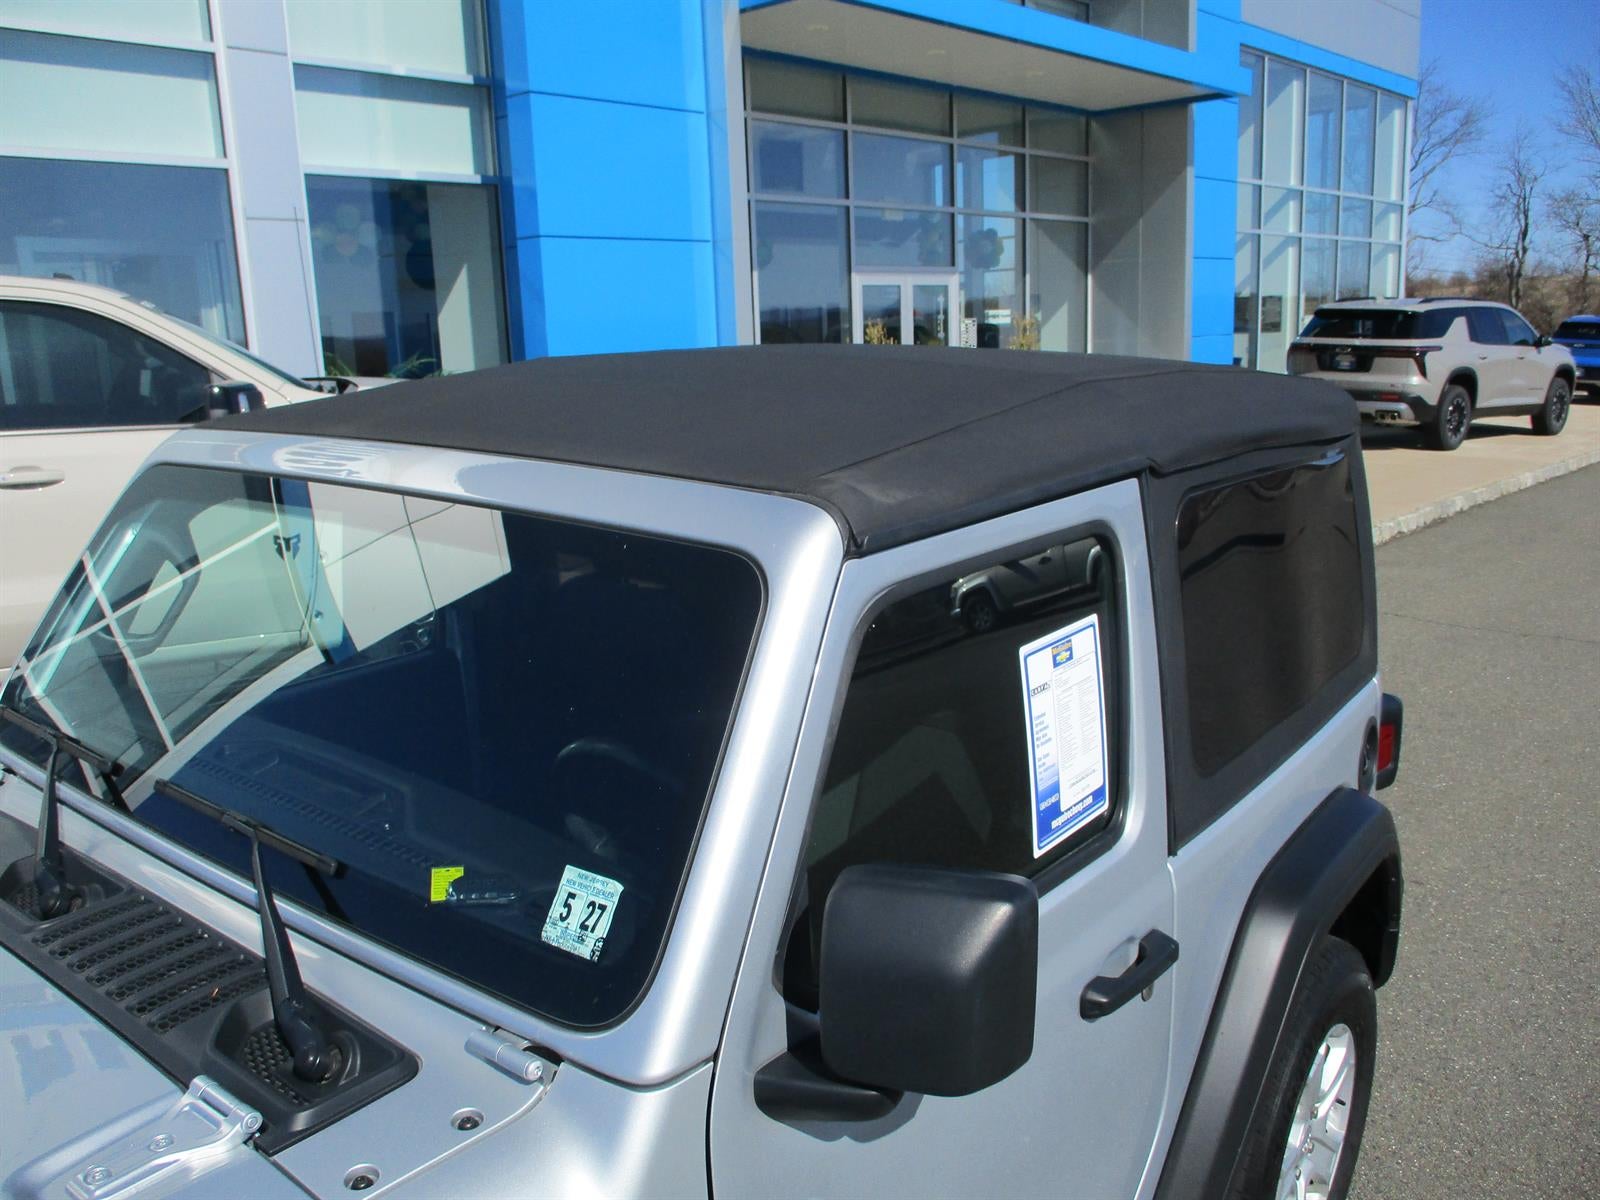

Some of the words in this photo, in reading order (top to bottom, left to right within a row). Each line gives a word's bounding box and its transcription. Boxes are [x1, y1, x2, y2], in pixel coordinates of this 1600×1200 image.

[596, 888, 615, 899] DEALER
[559, 892, 577, 922] 5
[579, 900, 608, 933] 27
